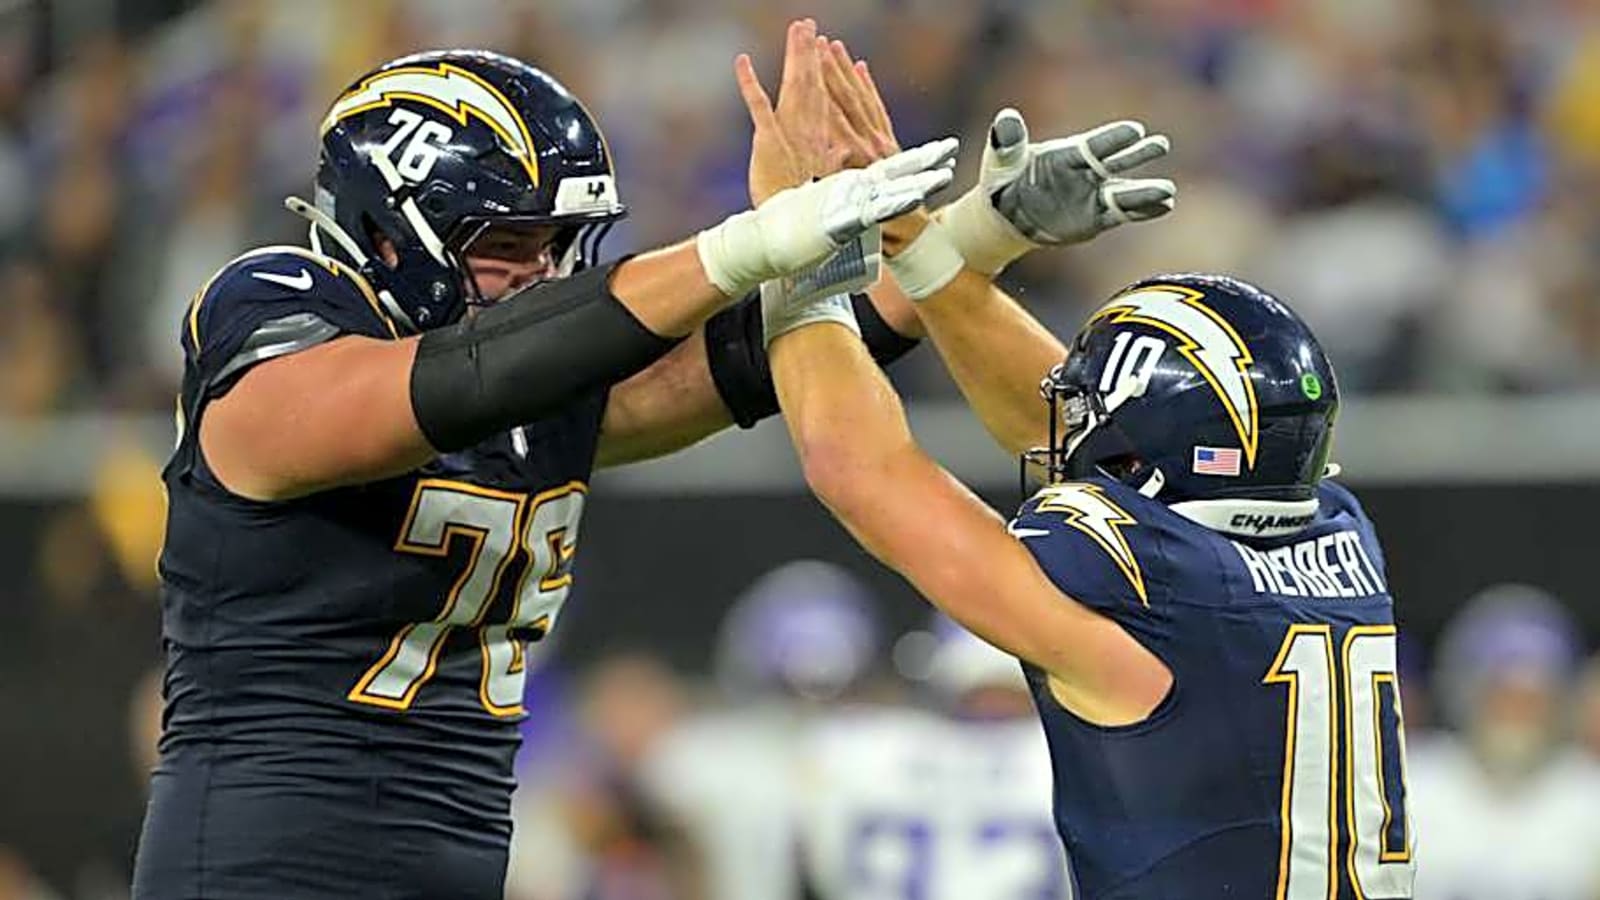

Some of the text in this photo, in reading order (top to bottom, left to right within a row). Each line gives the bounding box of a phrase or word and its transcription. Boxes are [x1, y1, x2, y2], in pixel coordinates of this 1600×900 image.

[372, 107, 453, 184] 76
[1099, 331, 1167, 398] 10
[348, 478, 590, 717] 76
[1229, 530, 1387, 599] HERBERT
[1262, 623, 1417, 900] 10
